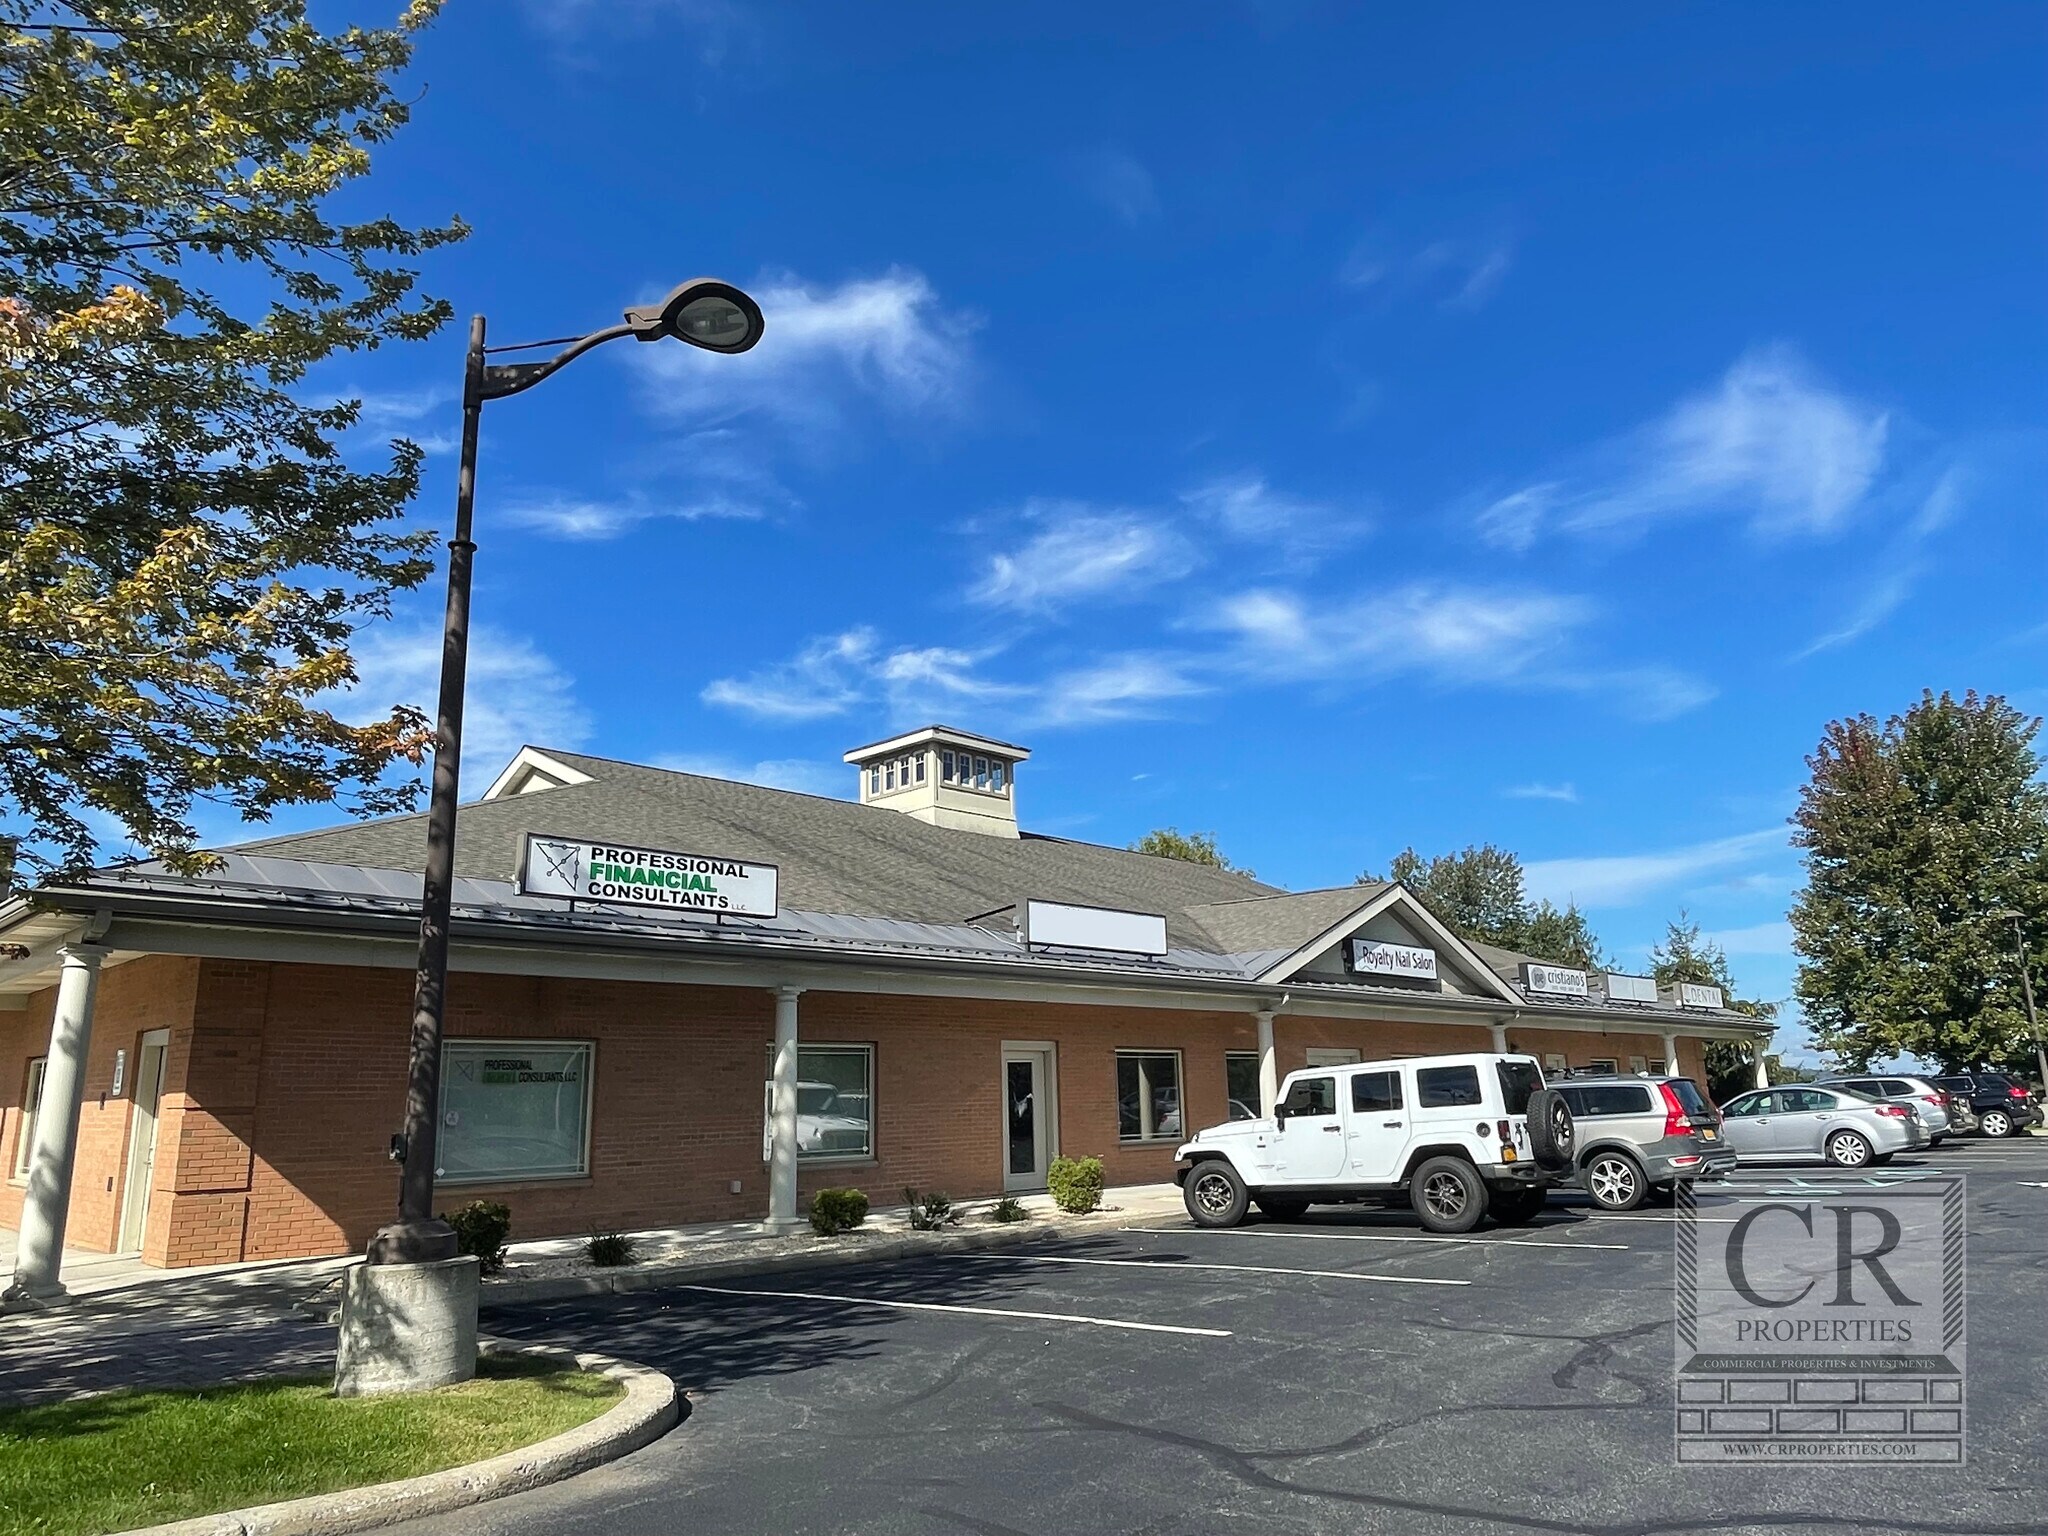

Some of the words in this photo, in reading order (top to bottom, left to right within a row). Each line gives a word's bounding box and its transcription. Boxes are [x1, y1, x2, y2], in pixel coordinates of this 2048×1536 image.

[590, 846, 749, 879] PROFESSIONAL
[589, 862, 718, 893] FINANCIAL
[588, 881, 729, 909] CONSULTANTS
[1362, 946, 1394, 970] Royalty
[1395, 951, 1411, 968] Nail
[1412, 952, 1434, 971] Salon
[1691, 987, 1721, 1005] DENTAL
[484, 1059, 533, 1071] PROFESSIONAL
